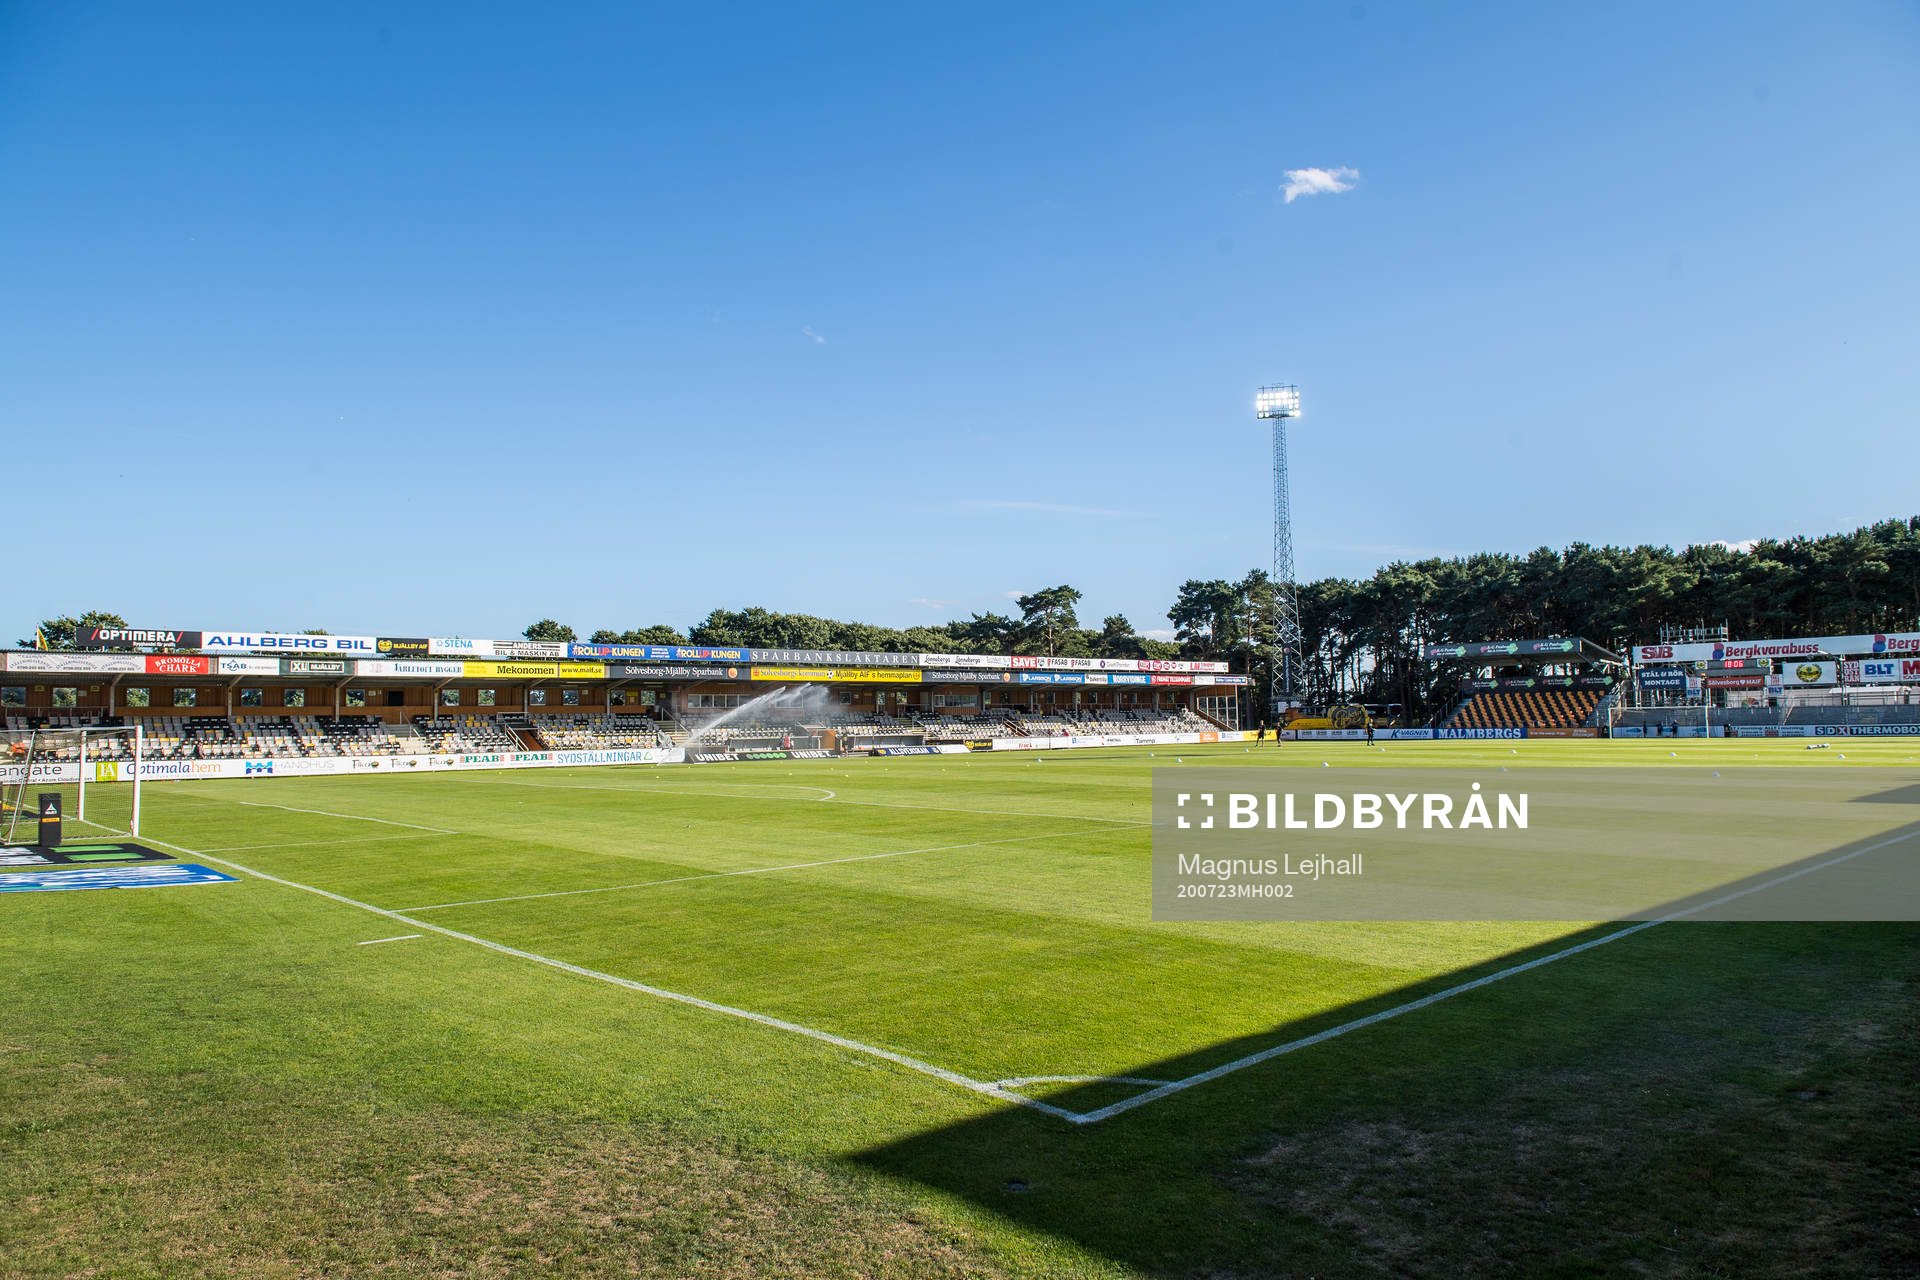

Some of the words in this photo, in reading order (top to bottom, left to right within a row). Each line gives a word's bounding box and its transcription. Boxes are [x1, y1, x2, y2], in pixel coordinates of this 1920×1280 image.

[207, 636, 328, 649] AHLBERG
[336, 639, 372, 650] BIL
[444, 639, 473, 648] STENA
[1725, 643, 1819, 659] Bergkvarabuss
[155, 656, 201, 668] BROMÖLLA
[221, 661, 247, 670] TSAB
[1012, 656, 1037, 667] SAVE
[159, 664, 197, 673] CHARK
[497, 665, 555, 674] Mekonomen
[625, 666, 690, 677] Sölvesborg-Mjällby
[692, 667, 723, 677] Sparbank
[1864, 663, 1894, 675] BLT
[1438, 727, 1522, 739] MALMBERGS
[464, 755, 499, 763] PEAB
[515, 753, 548, 761] PEAB
[557, 751, 642, 764] SYDSTÄLLNINGAR
[695, 753, 739, 762] UNIBET
[791, 750, 831, 759] UNIBET
